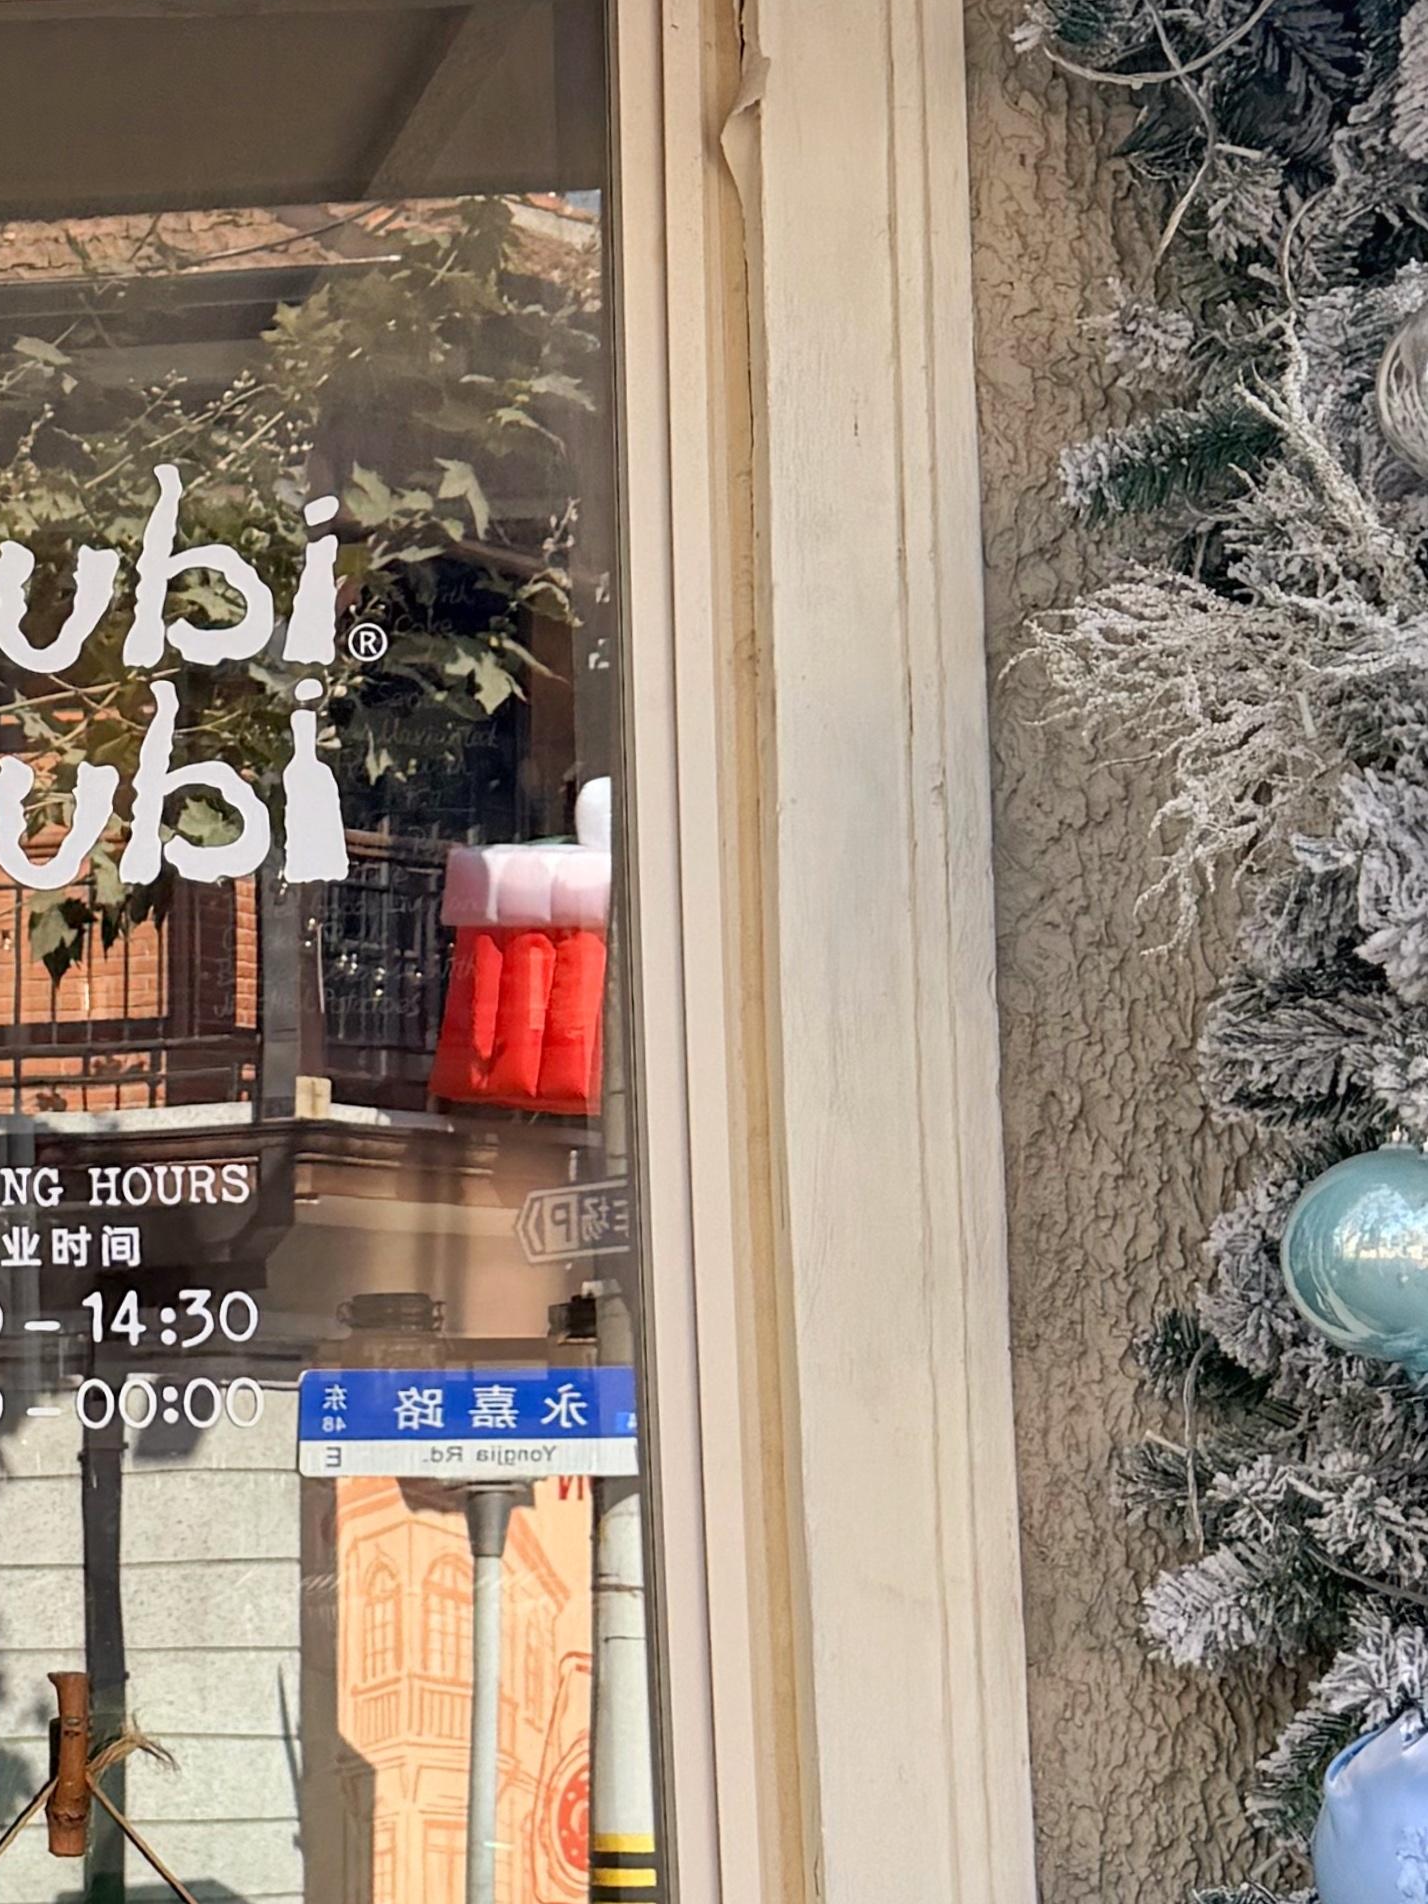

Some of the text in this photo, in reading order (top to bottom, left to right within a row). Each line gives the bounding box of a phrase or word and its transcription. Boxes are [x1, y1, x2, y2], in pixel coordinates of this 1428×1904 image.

[88, 1164, 251, 1206] HOURS
[82, 1289, 259, 1348] 14:30
[76, 1378, 264, 1430] 00:00
